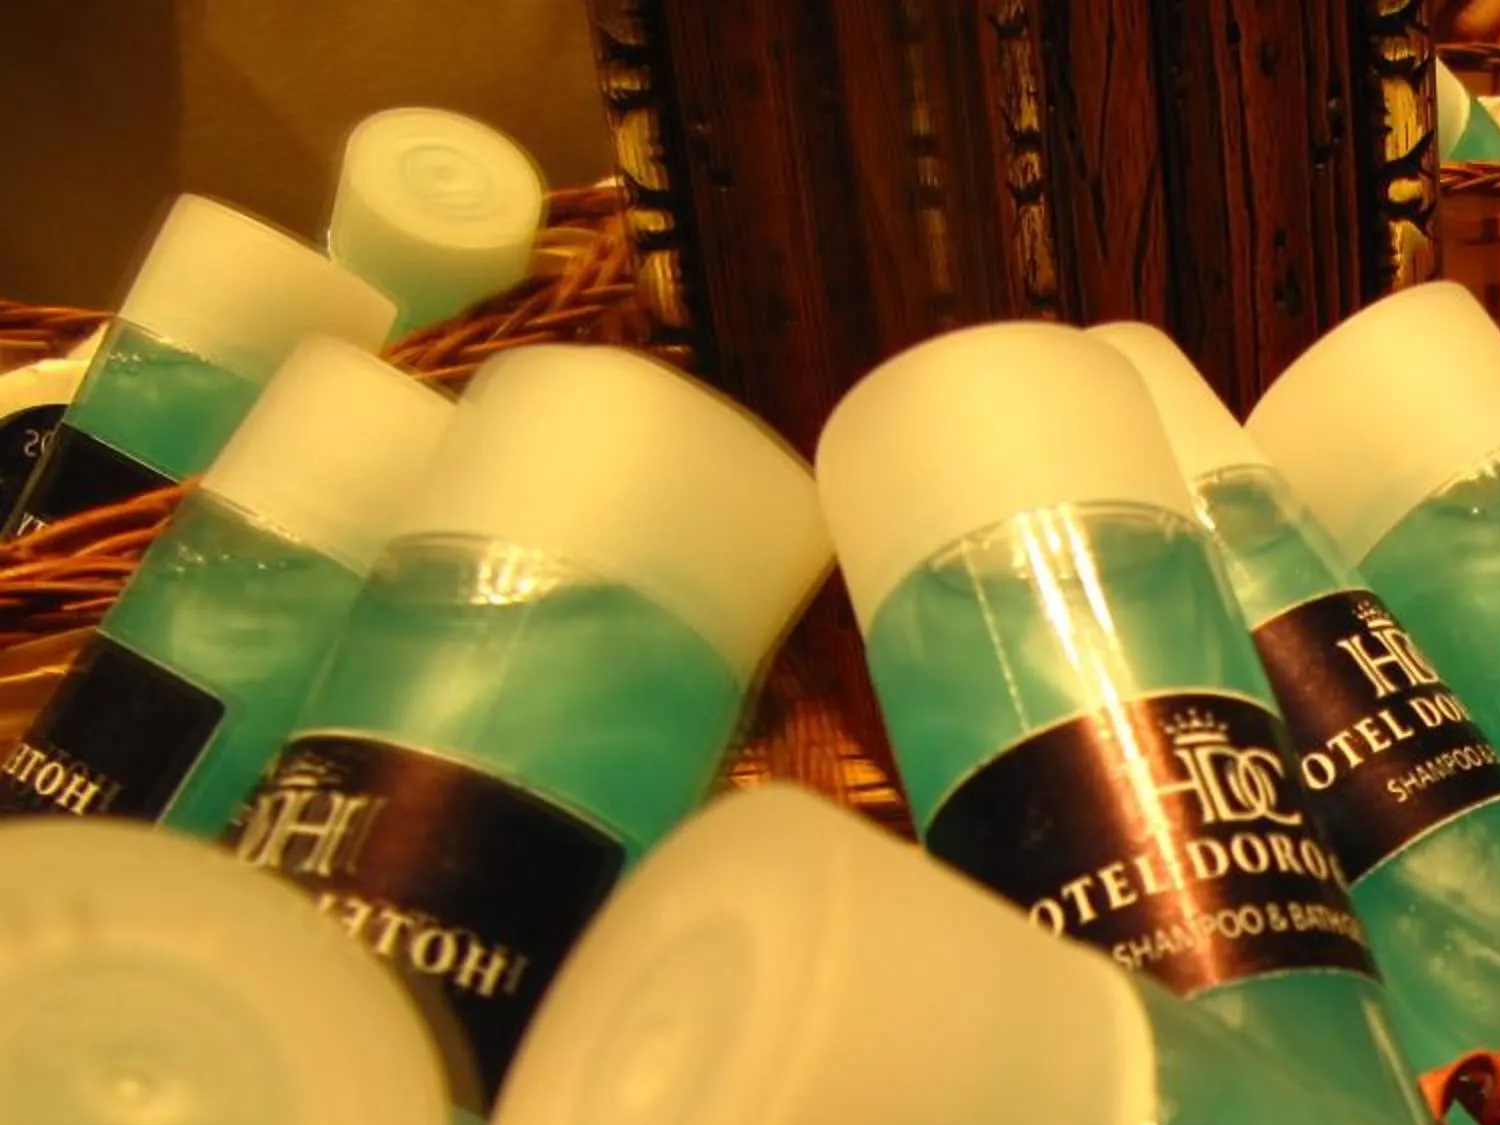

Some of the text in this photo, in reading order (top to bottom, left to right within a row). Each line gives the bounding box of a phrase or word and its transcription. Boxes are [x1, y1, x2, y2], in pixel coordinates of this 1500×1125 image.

[1301, 708, 1415, 790] OTEL
[1027, 856, 1178, 940] OTEL
[1186, 832, 1328, 881] DORO
